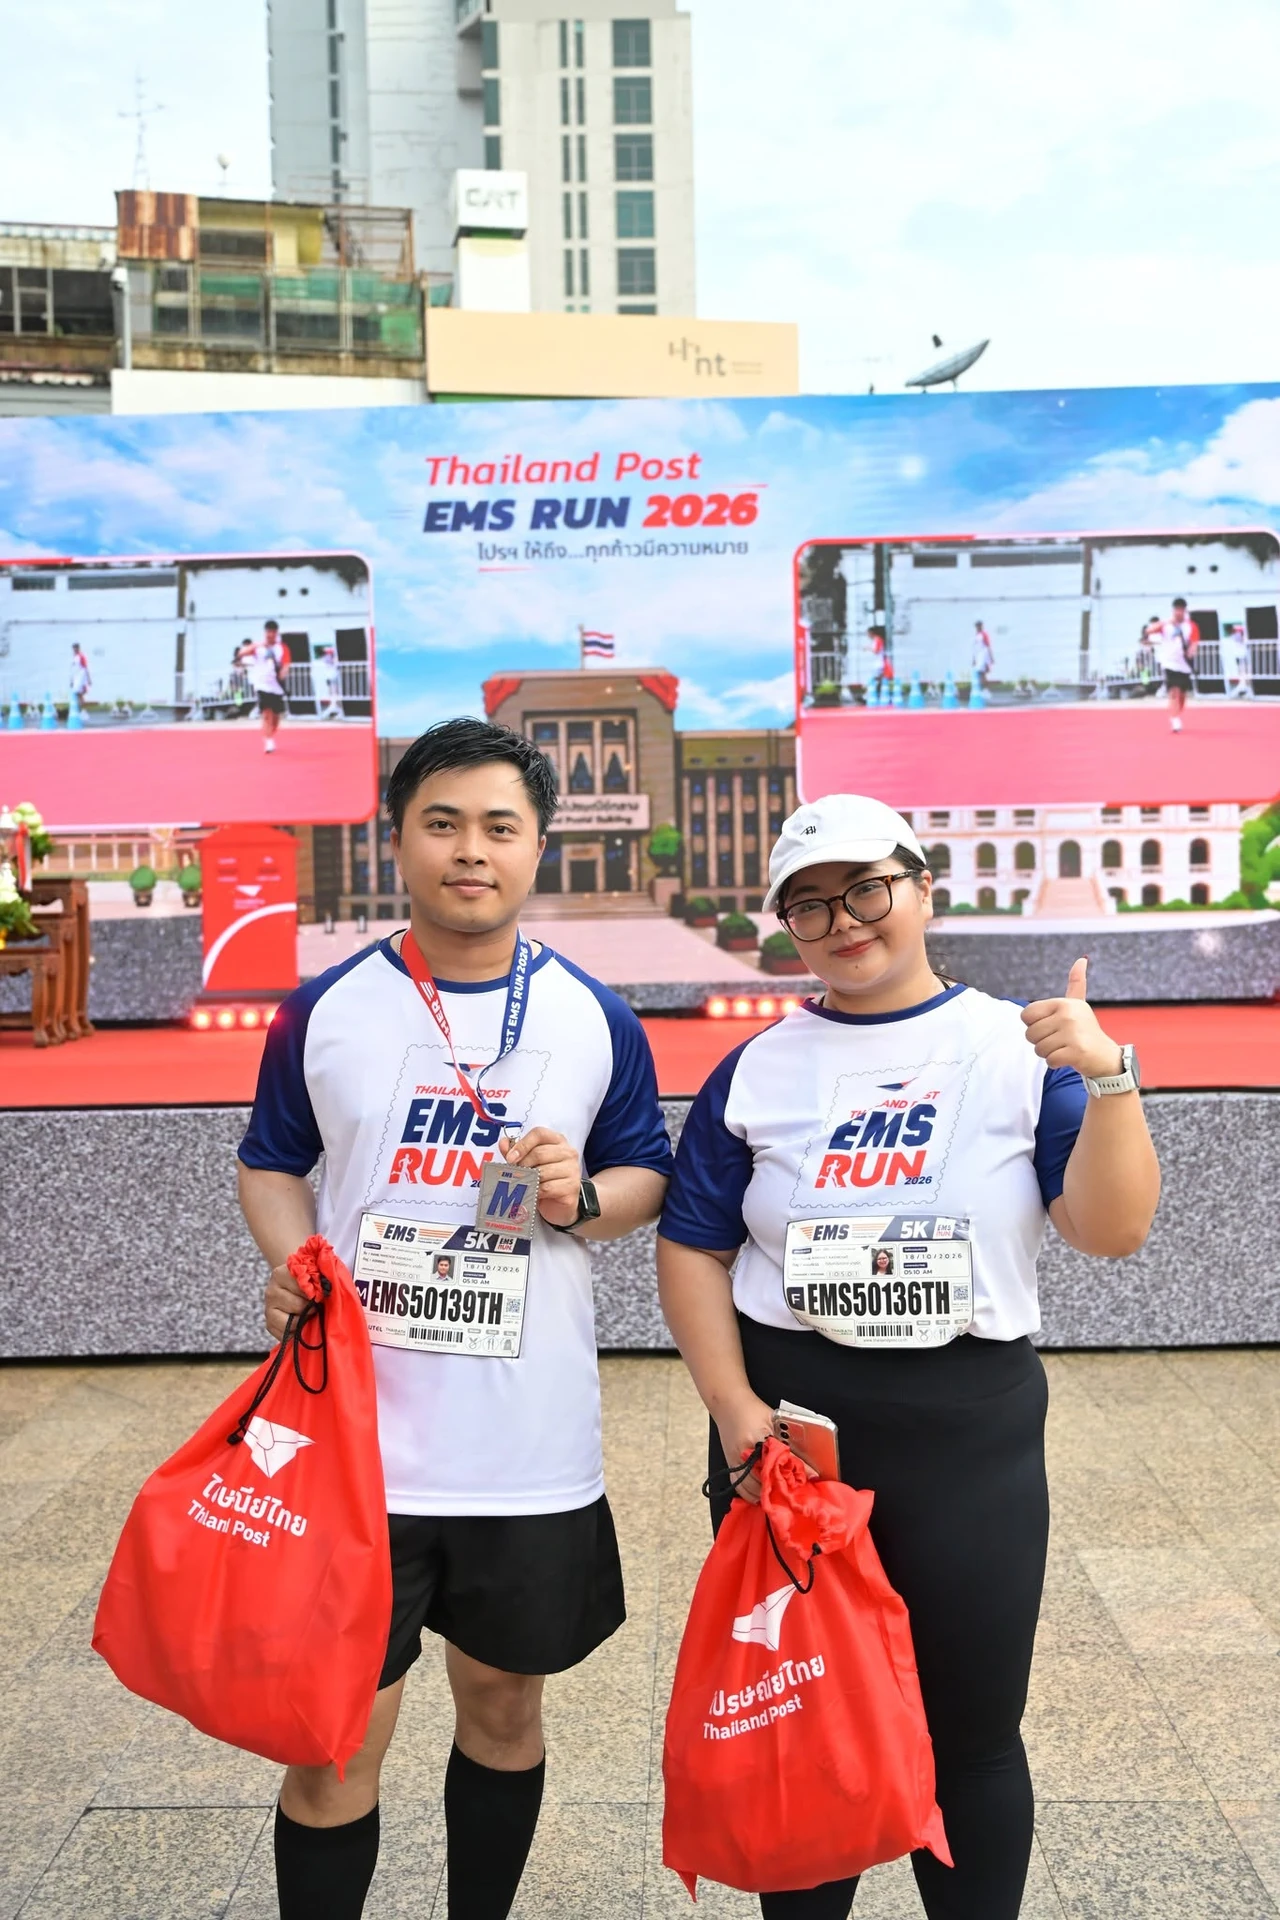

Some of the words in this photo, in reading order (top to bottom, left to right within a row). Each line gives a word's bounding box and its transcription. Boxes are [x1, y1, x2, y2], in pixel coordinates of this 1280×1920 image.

[425, 452, 600, 486] Thailand
[614, 452, 703, 481] Post
[423, 499, 516, 533] EMS
[529, 496, 631, 531] RUN
[642, 492, 759, 528] 2026
[517, 945, 529, 974] 2026
[513, 974, 525, 1000] RUN
[508, 1001, 521, 1027] EMS
[415, 1085, 469, 1097] THAILAN
[400, 1098, 507, 1147] EMS
[828, 1103, 937, 1150] EMS
[388, 1147, 495, 1187] RUN
[814, 1149, 927, 1188] RUN
[903, 1175, 932, 1185] 2026
[486, 1181, 528, 1218] M
[383, 1223, 417, 1243] EMS
[463, 1231, 493, 1250] 5K
[499, 1237, 514, 1245] EMS
[813, 1224, 850, 1240] EMS
[900, 1220, 930, 1239] 5K
[369, 1278, 503, 1325] EMS50139TH
[807, 1280, 950, 1317] EMS50136TH
[232, 1520, 270, 1547] Post
[703, 1708, 769, 1740] Thailand
[769, 1693, 803, 1723] Post
